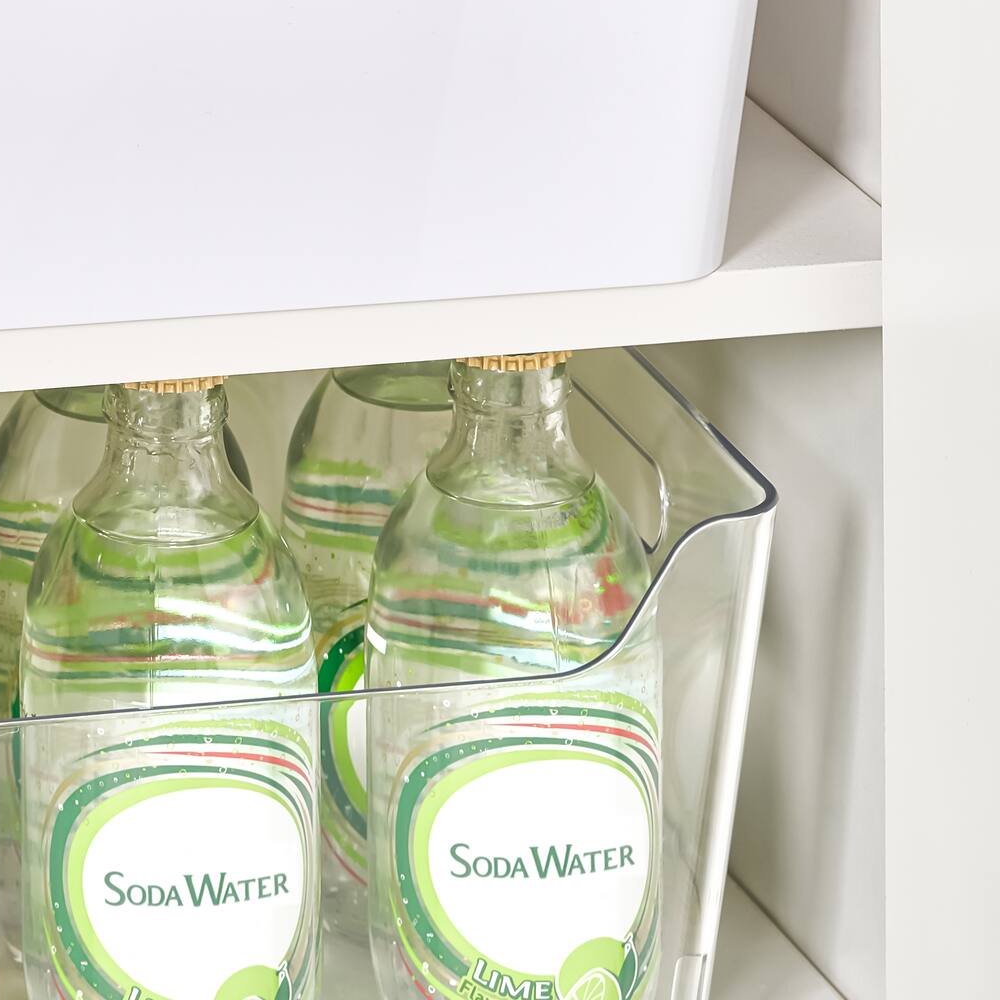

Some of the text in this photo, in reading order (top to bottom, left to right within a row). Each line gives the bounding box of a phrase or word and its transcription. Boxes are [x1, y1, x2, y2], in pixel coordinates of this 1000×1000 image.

[449, 842, 635, 880] SODA WATER
[104, 871, 289, 908] SODA WATER
[472, 957, 555, 1000] LIME
